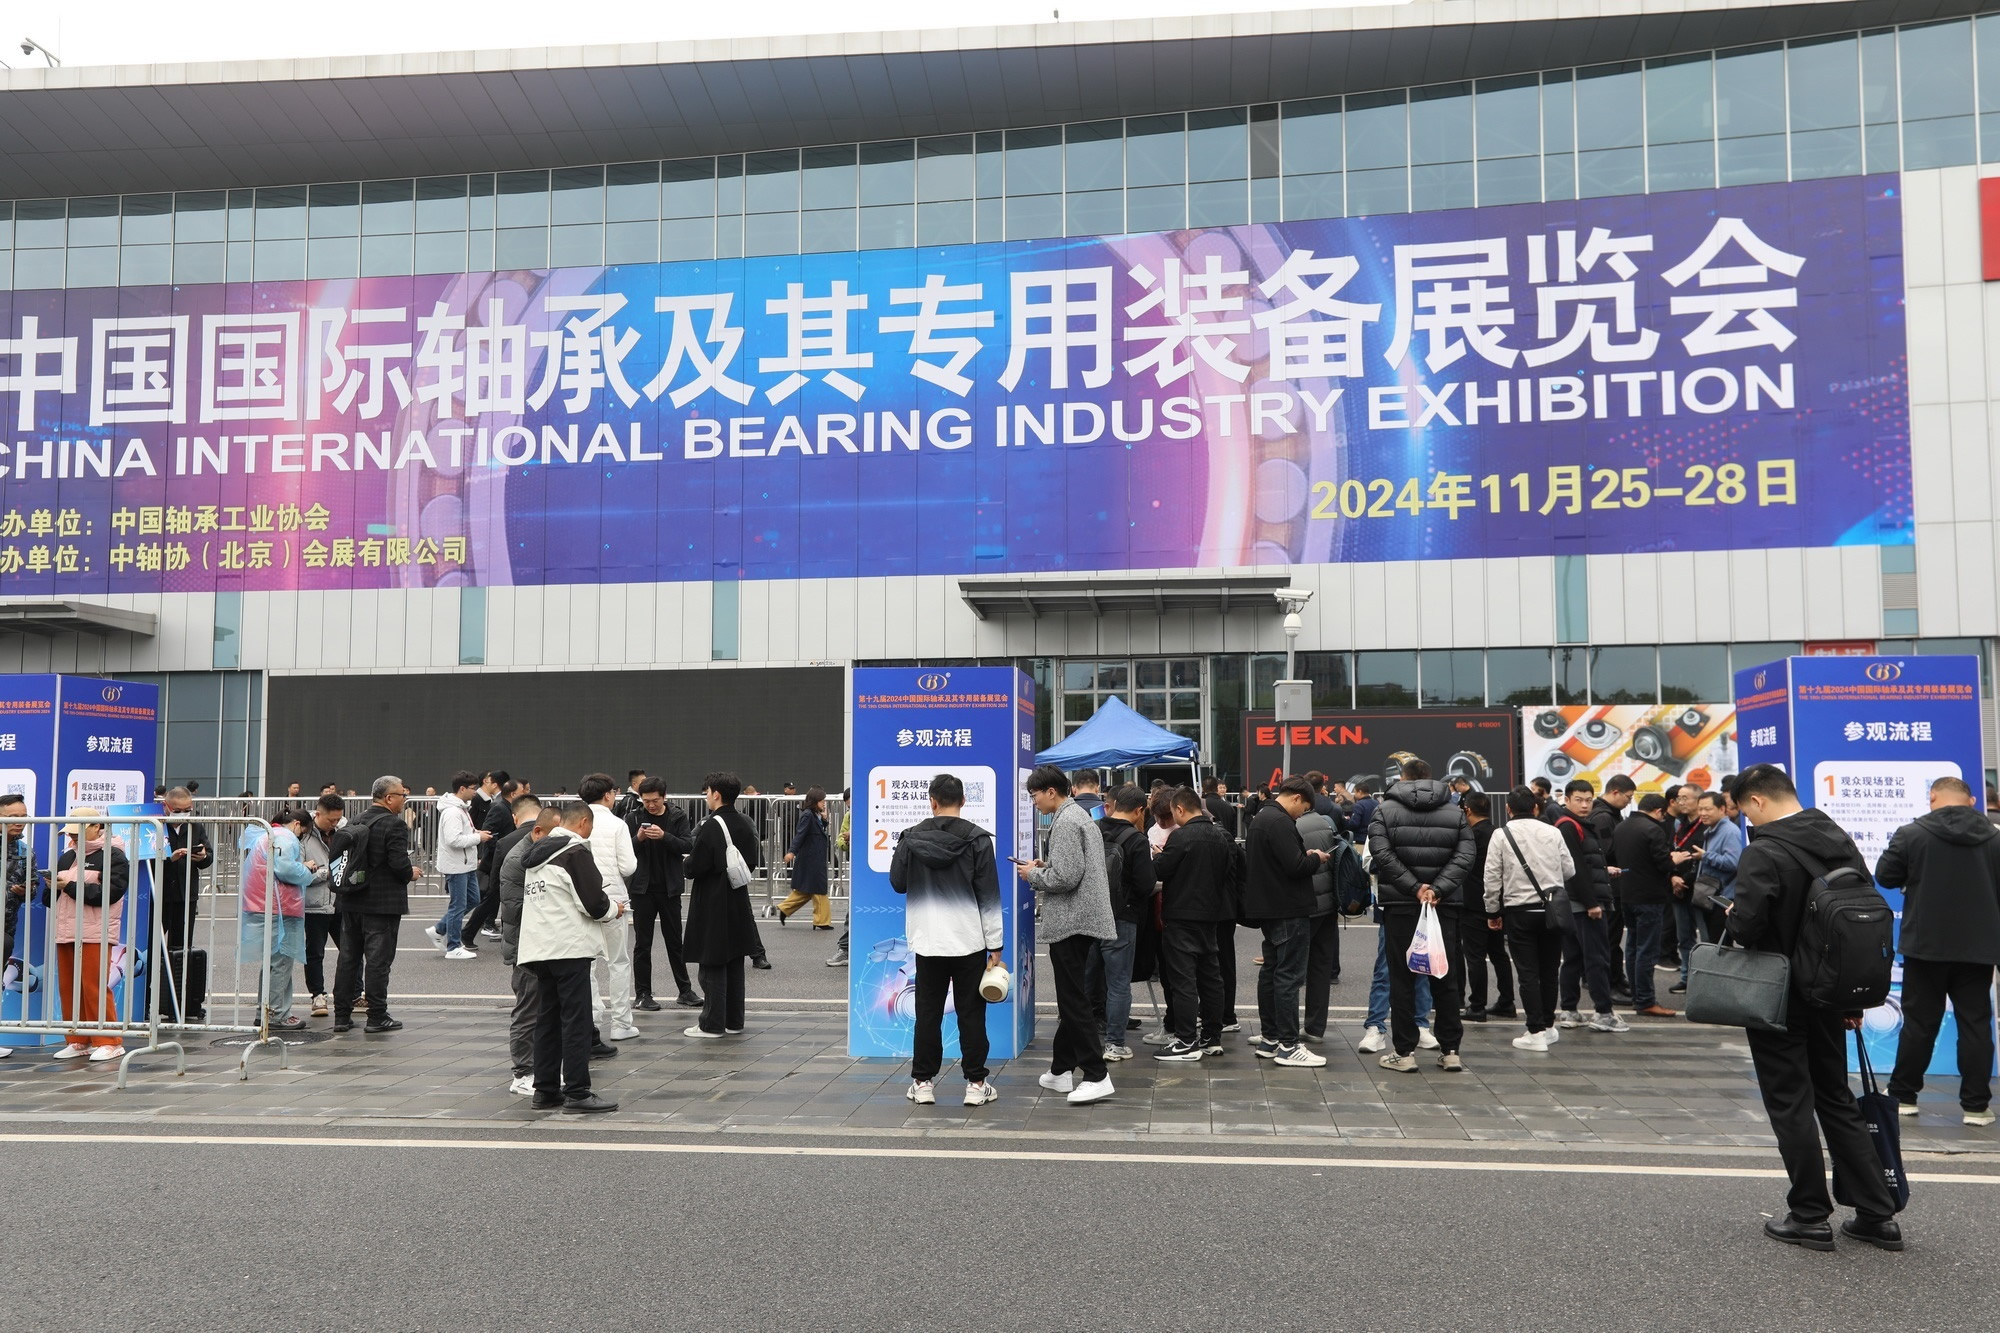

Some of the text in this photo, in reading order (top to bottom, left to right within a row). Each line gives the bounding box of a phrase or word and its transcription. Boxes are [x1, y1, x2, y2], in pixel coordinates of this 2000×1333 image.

[0, 217, 1805, 431] 中国国际轴承及其专用装备展览会
[175, 423, 664, 475] INTERNATIONAL
[684, 407, 972, 460] BEARING
[996, 388, 1344, 447] INDUSTRY
[1368, 363, 1795, 430] EXHIBITION
[896, 728, 973, 748] 参观流程
[1750, 726, 1777, 748] 参观流程
[1843, 721, 1933, 742] 参观流程
[86, 735, 133, 754] 参观流程
[71, 781, 79, 800] 1
[81, 782, 116, 791] 观众现场登记
[876, 779, 886, 799] 1
[891, 780, 931, 790] 观众现场
[1823, 775, 1835, 796] 1
[1841, 776, 1906, 787] 观众现场登记
[81, 793, 116, 802] 实名认证流程
[1841, 788, 1906, 799] 实名认证流程
[873, 829, 889, 850] 2
[335, 850, 349, 887] adidas
